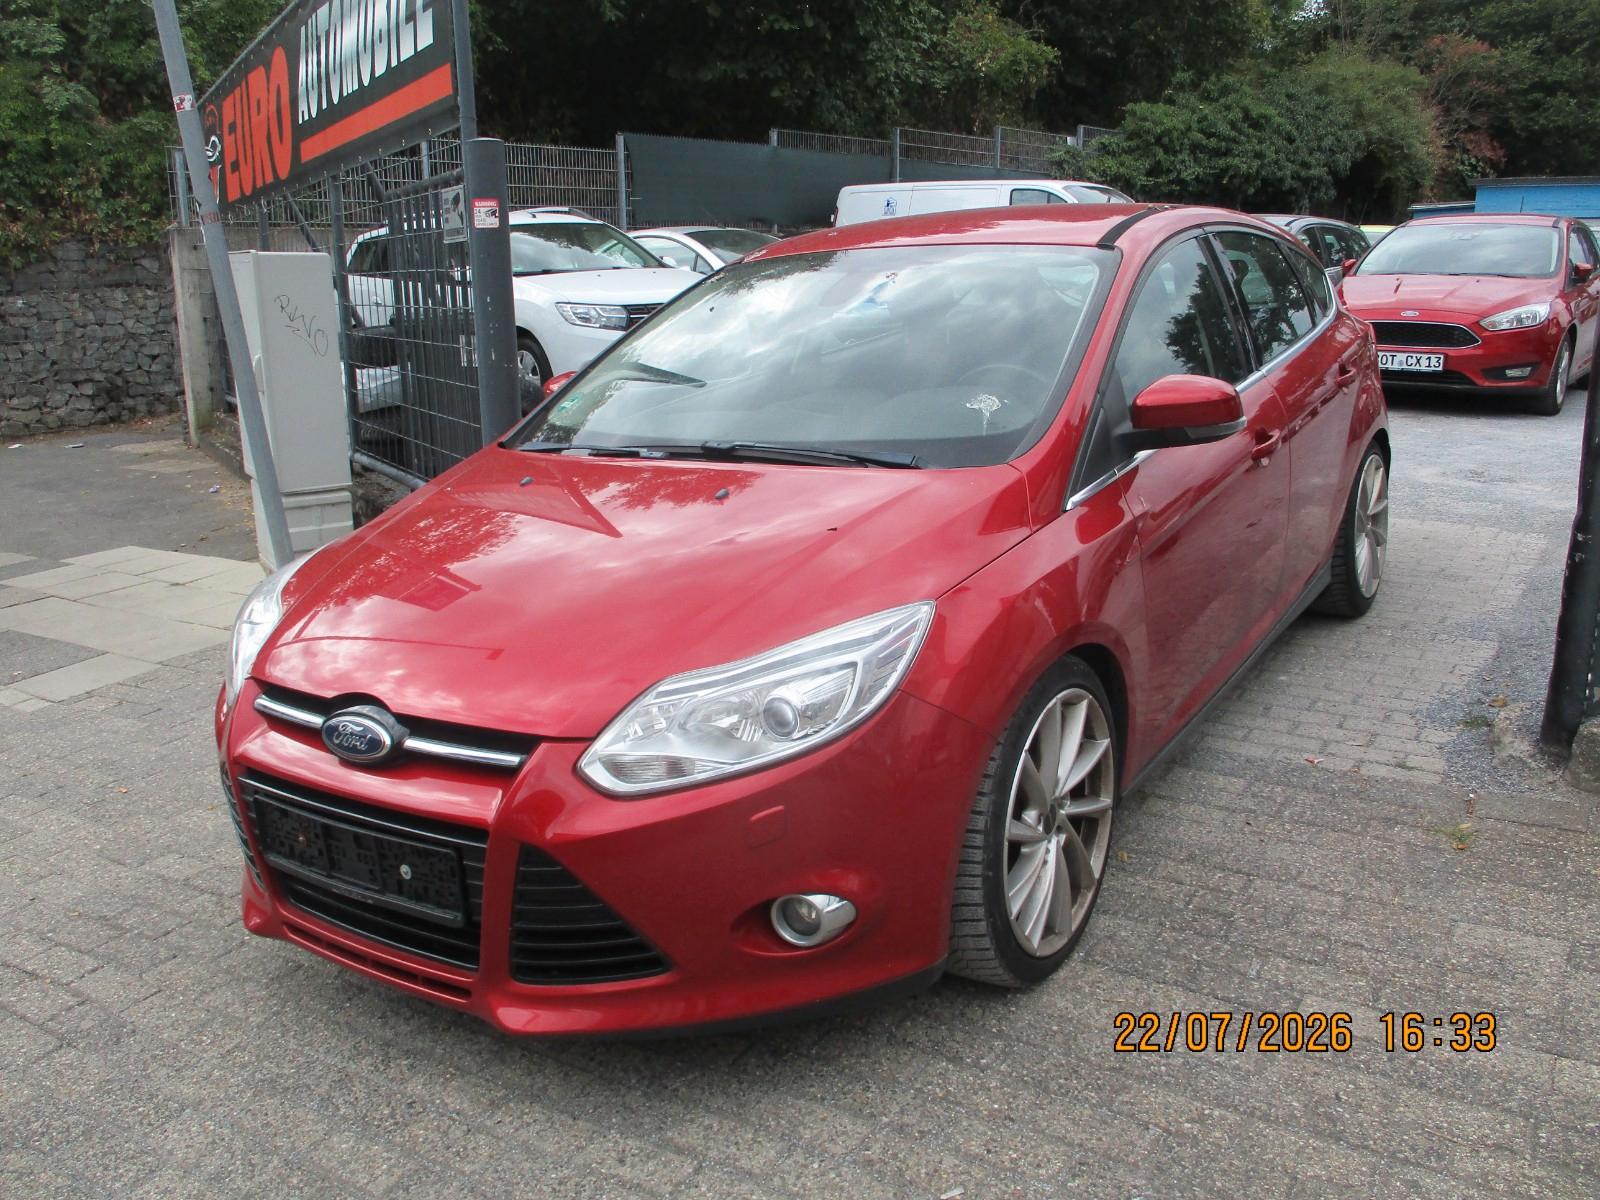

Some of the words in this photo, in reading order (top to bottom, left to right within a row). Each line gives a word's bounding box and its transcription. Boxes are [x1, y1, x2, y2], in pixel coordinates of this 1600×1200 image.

[221, 46, 292, 203] EURO
[1377, 354, 1397, 366] OT
[333, 721, 372, 751] Ford
